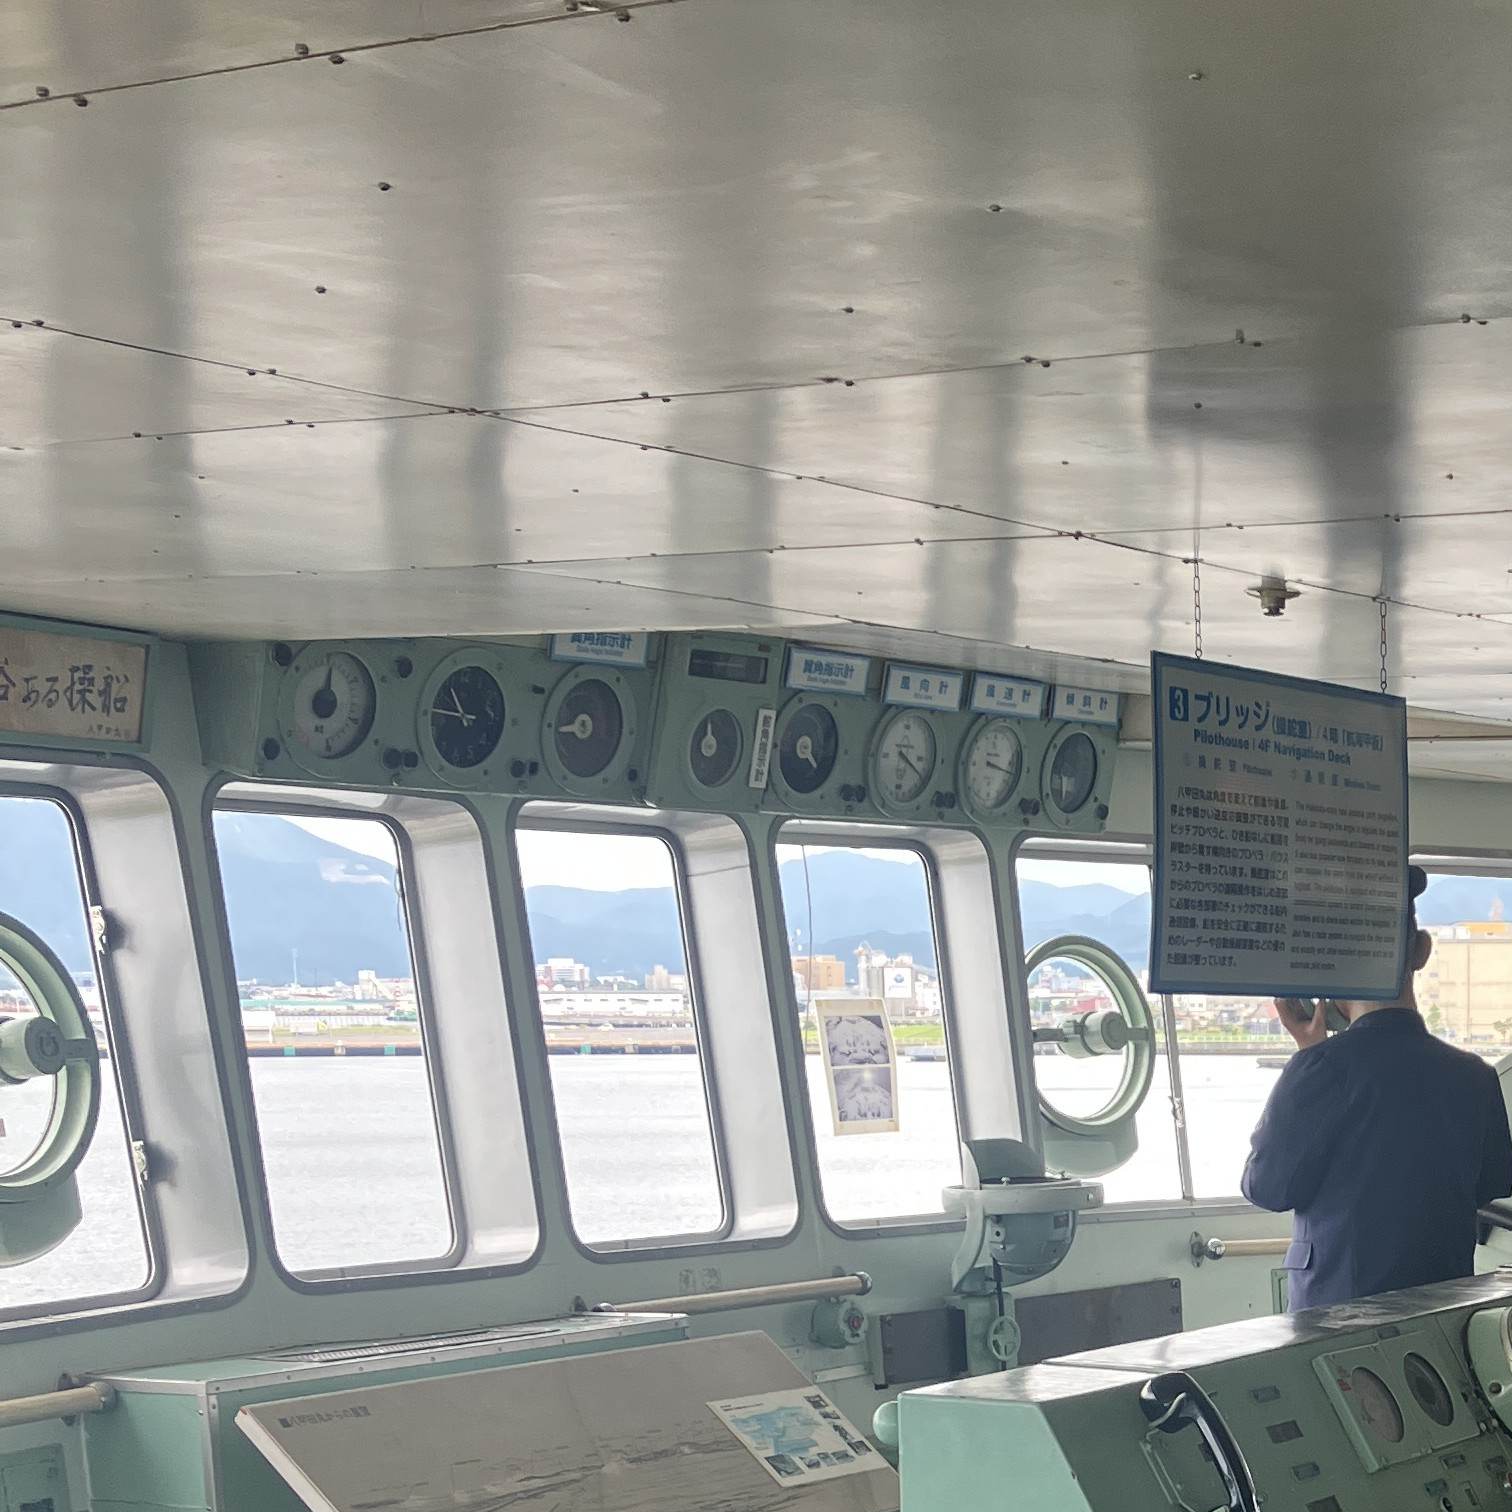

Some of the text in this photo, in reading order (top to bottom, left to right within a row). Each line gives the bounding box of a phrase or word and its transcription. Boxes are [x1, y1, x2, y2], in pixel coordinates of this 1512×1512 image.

[1193, 728, 1250, 750] Pilothouse
[1258, 738, 1271, 754] 4F
[1274, 741, 1326, 761] Navigation
[1328, 748, 1352, 766] Deck
